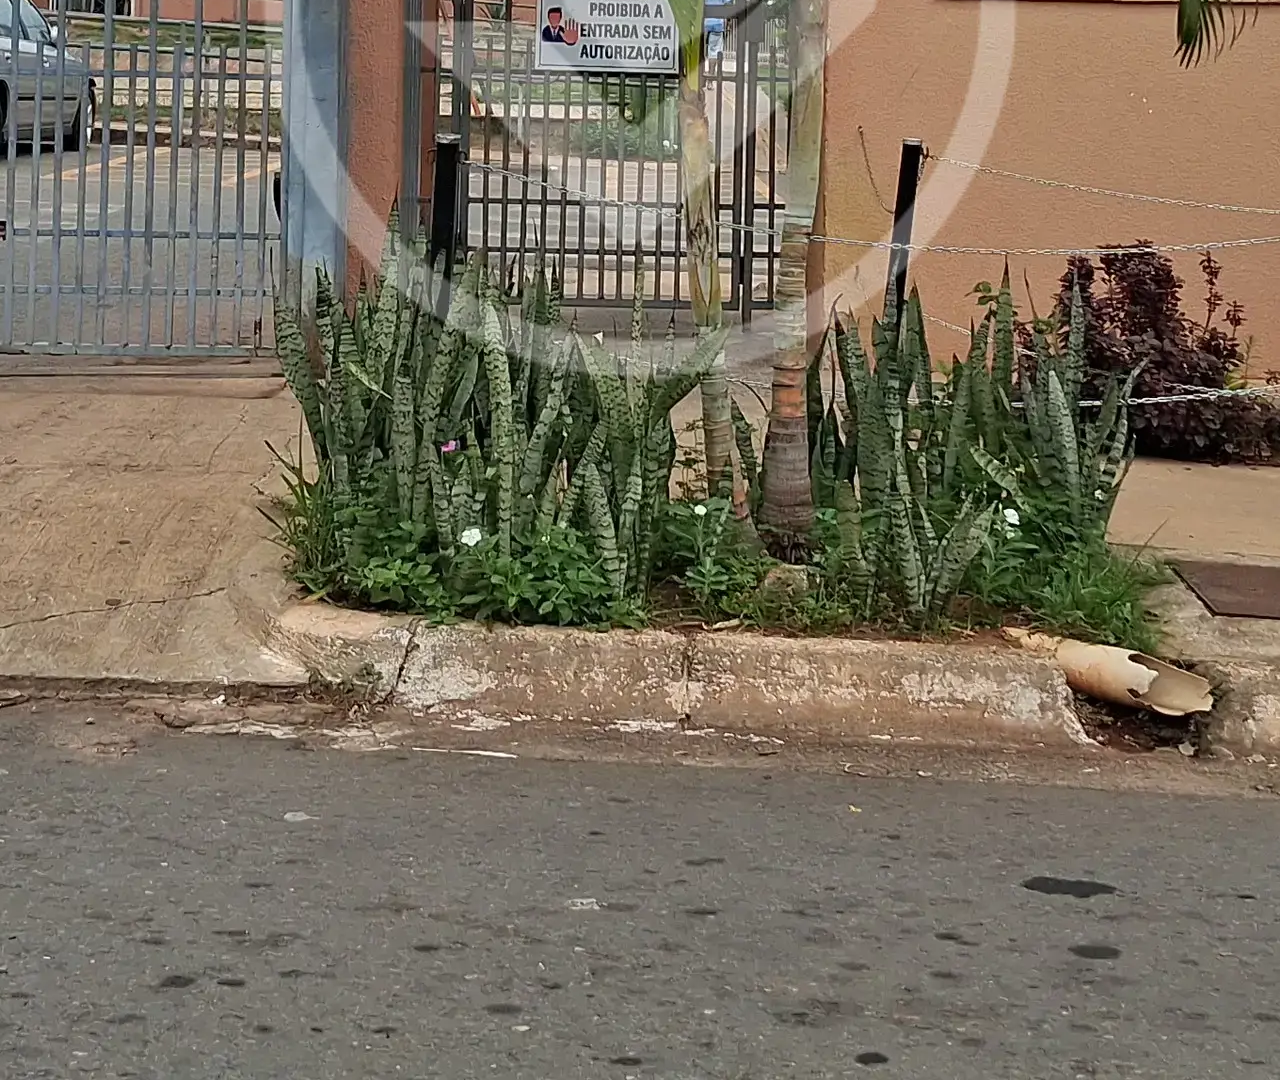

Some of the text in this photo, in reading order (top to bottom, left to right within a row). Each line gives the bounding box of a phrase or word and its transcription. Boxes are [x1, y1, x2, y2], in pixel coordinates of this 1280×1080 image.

[589, 2, 663, 18] PROIBIDA A
[580, 23, 671, 40] ENTRADA SEM
[579, 43, 670, 64] AUTORIZAÇÃO
